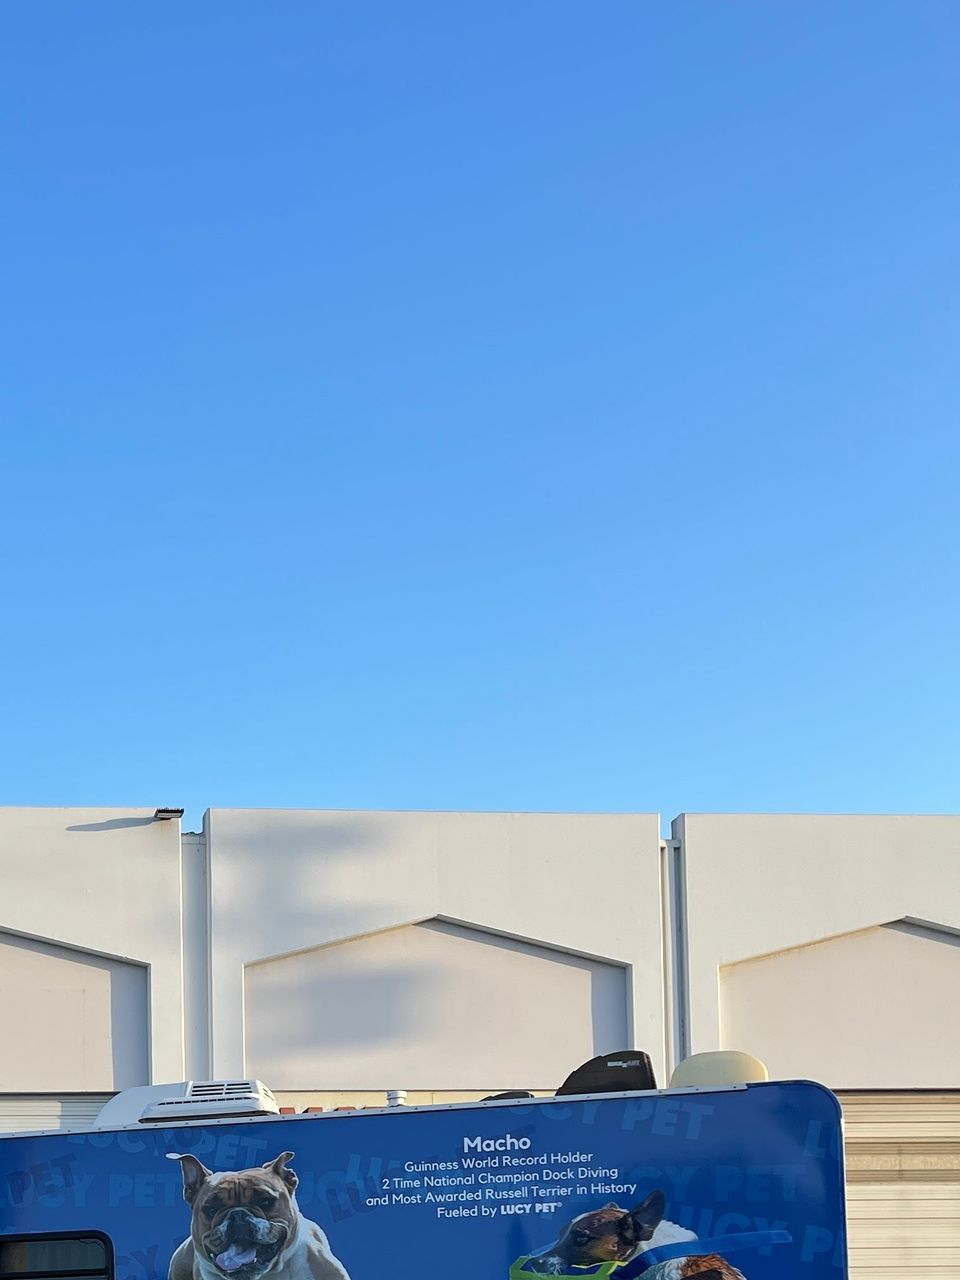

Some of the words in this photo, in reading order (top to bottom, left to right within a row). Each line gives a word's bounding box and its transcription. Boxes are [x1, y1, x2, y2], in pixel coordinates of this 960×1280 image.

[464, 1134, 530, 1152] Macho
[405, 1161, 458, 1172] Guinness
[462, 1157, 498, 1168] World
[503, 1154, 547, 1167] Record
[551, 1152, 593, 1164] Holder
[382, 1179, 390, 1189] 2
[393, 1177, 420, 1188] Time
[424, 1174, 474, 1187] National
[478, 1171, 539, 1186] Champion
[543, 1168, 574, 1180] Dock
[578, 1166, 618, 1182] Diving
[367, 1195, 388, 1206] and
[392, 1193, 421, 1204] Most
[425, 1189, 481, 1202] Awarded
[486, 1187, 528, 1200] Russell
[531, 1184, 573, 1197] Terrier
[577, 1184, 587, 1194] in
[591, 1182, 637, 1196] History
[438, 1205, 478, 1217] Fueled
[482, 1204, 497, 1218] by
[501, 1204, 531, 1214] LUCY
